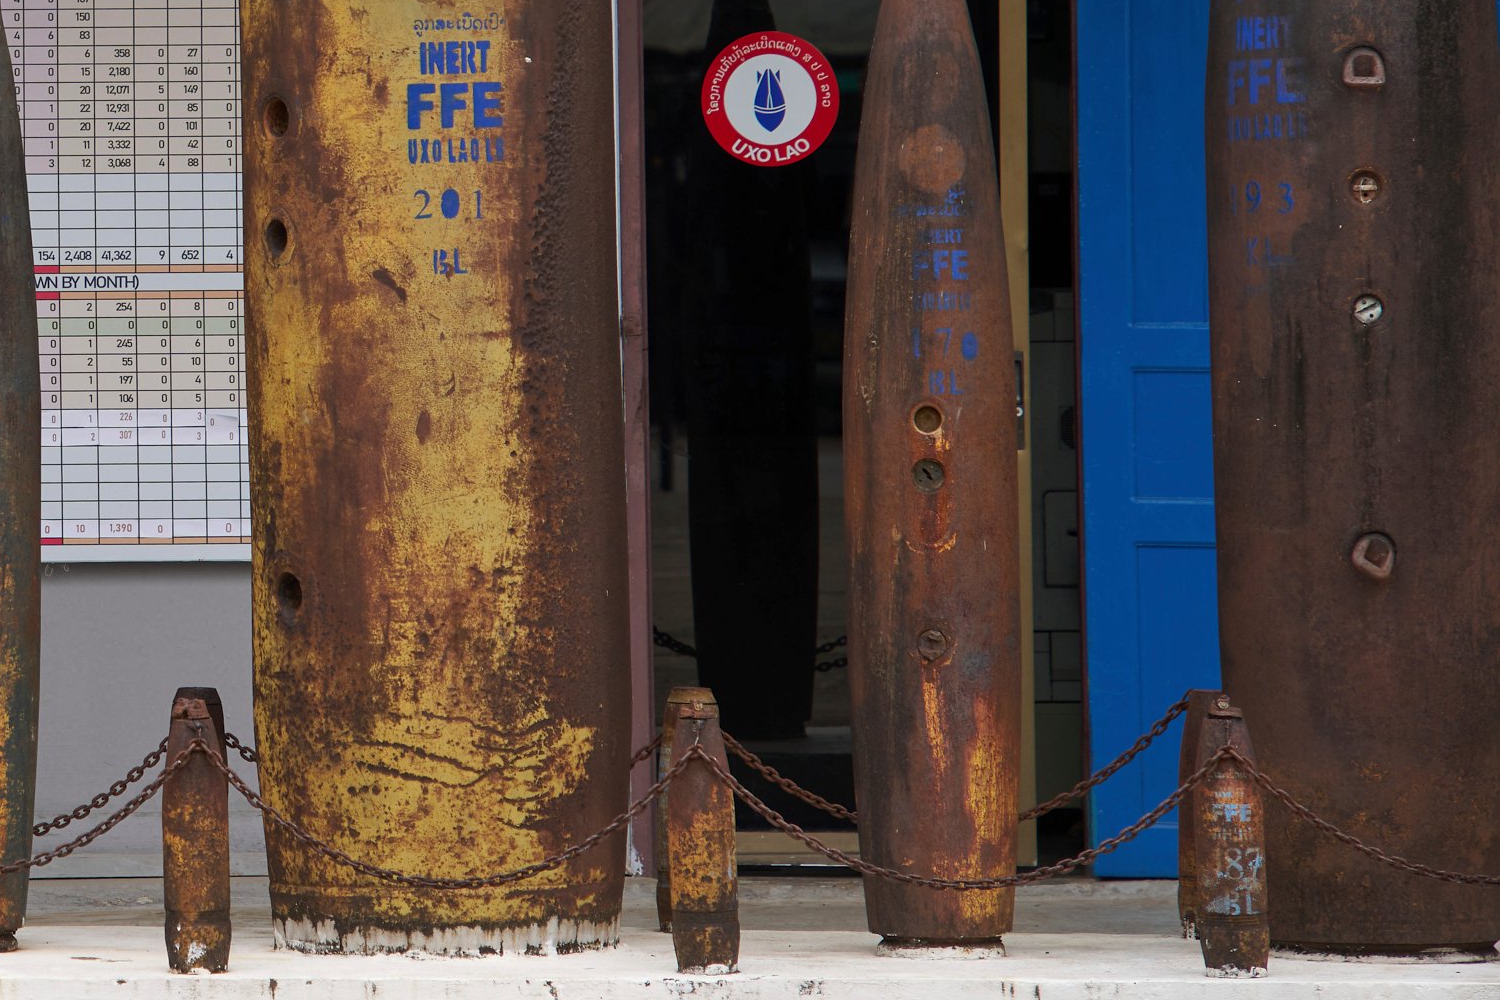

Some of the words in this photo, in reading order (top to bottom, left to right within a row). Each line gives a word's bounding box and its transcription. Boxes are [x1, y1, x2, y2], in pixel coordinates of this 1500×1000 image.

[1236, 14, 1293, 51] INERT
[419, 40, 491, 75] INERT
[106, 84, 131, 96] 12,071
[406, 81, 503, 130] FFE
[408, 139, 442, 164] UXO
[448, 138, 480, 163] LAO
[731, 138, 772, 163] UXO
[774, 138, 811, 163] LAO
[64, 250, 93, 262] 2,408
[101, 250, 132, 262] 41,362
[180, 250, 200, 261] 652
[433, 248, 468, 275] BL
[62, 276, 79, 288] BY
[83, 275, 140, 289] MONTH)
[115, 302, 133, 313] 254
[109, 523, 133, 534] 1,390
